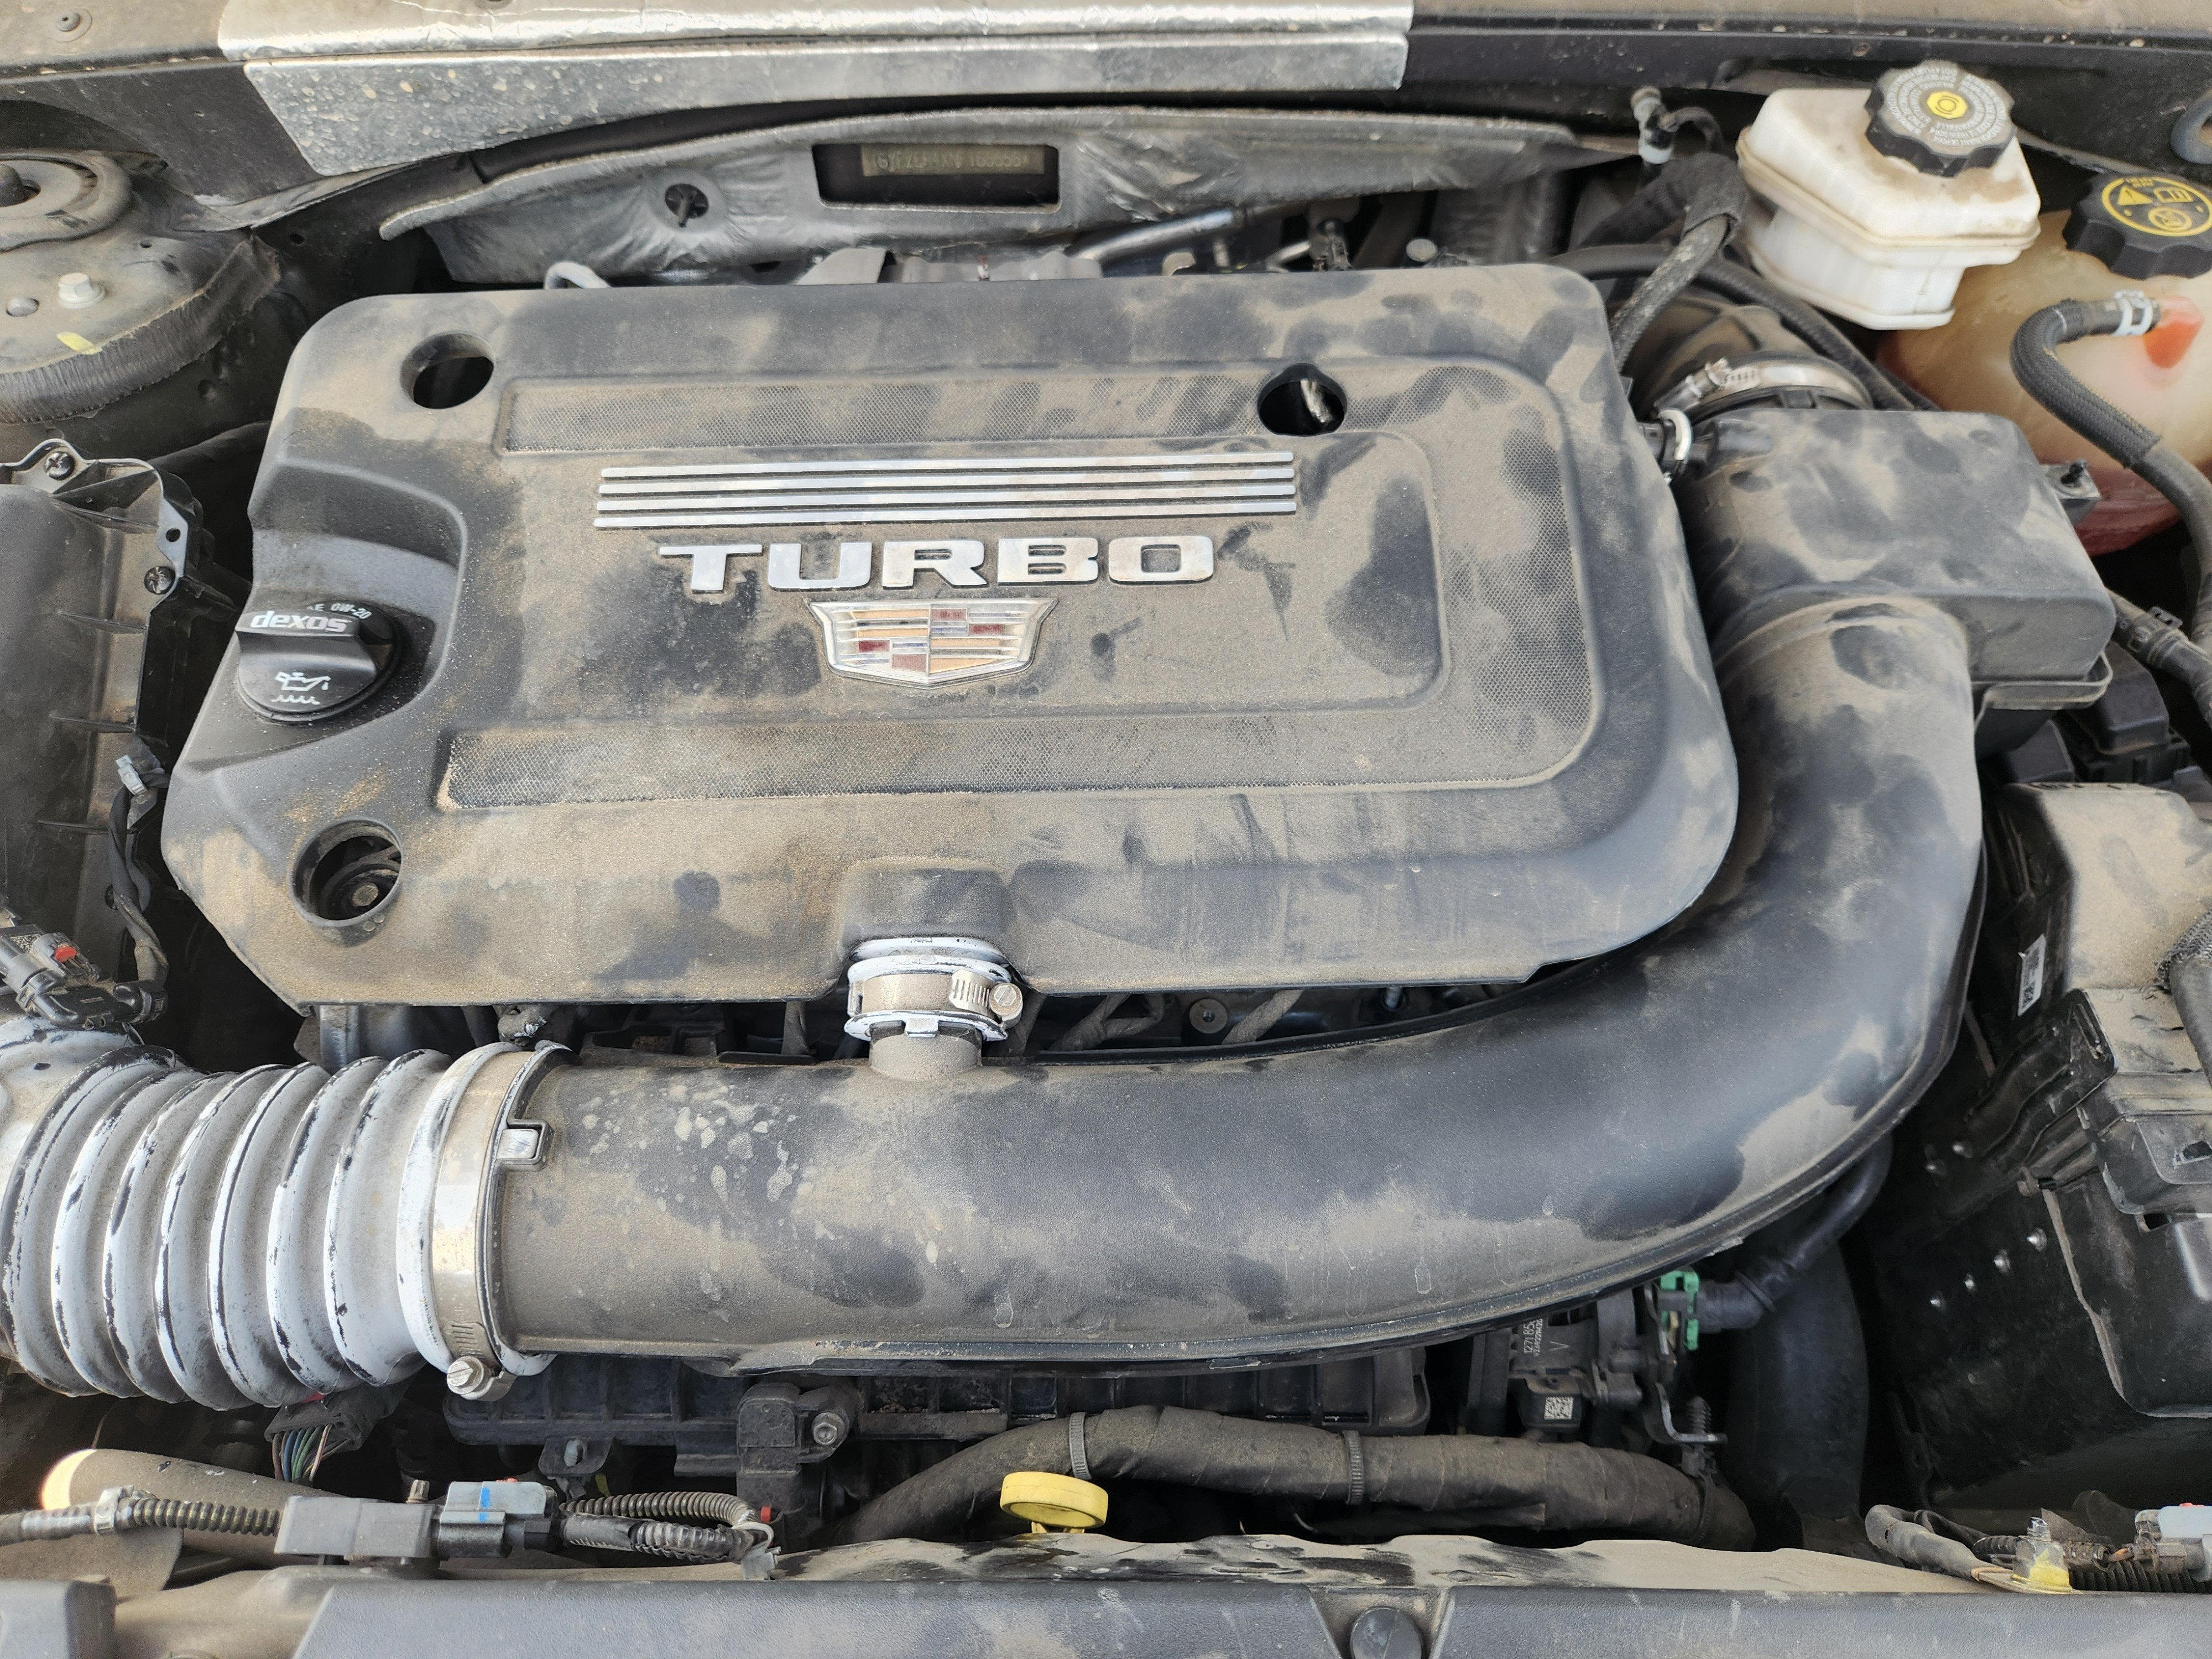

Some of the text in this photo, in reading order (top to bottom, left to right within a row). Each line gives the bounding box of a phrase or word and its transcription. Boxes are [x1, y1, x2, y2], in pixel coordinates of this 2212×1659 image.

[660, 535, 1214, 591] TURBO
[250, 610, 352, 633] dexos
[330, 603, 373, 619] 0W-20
